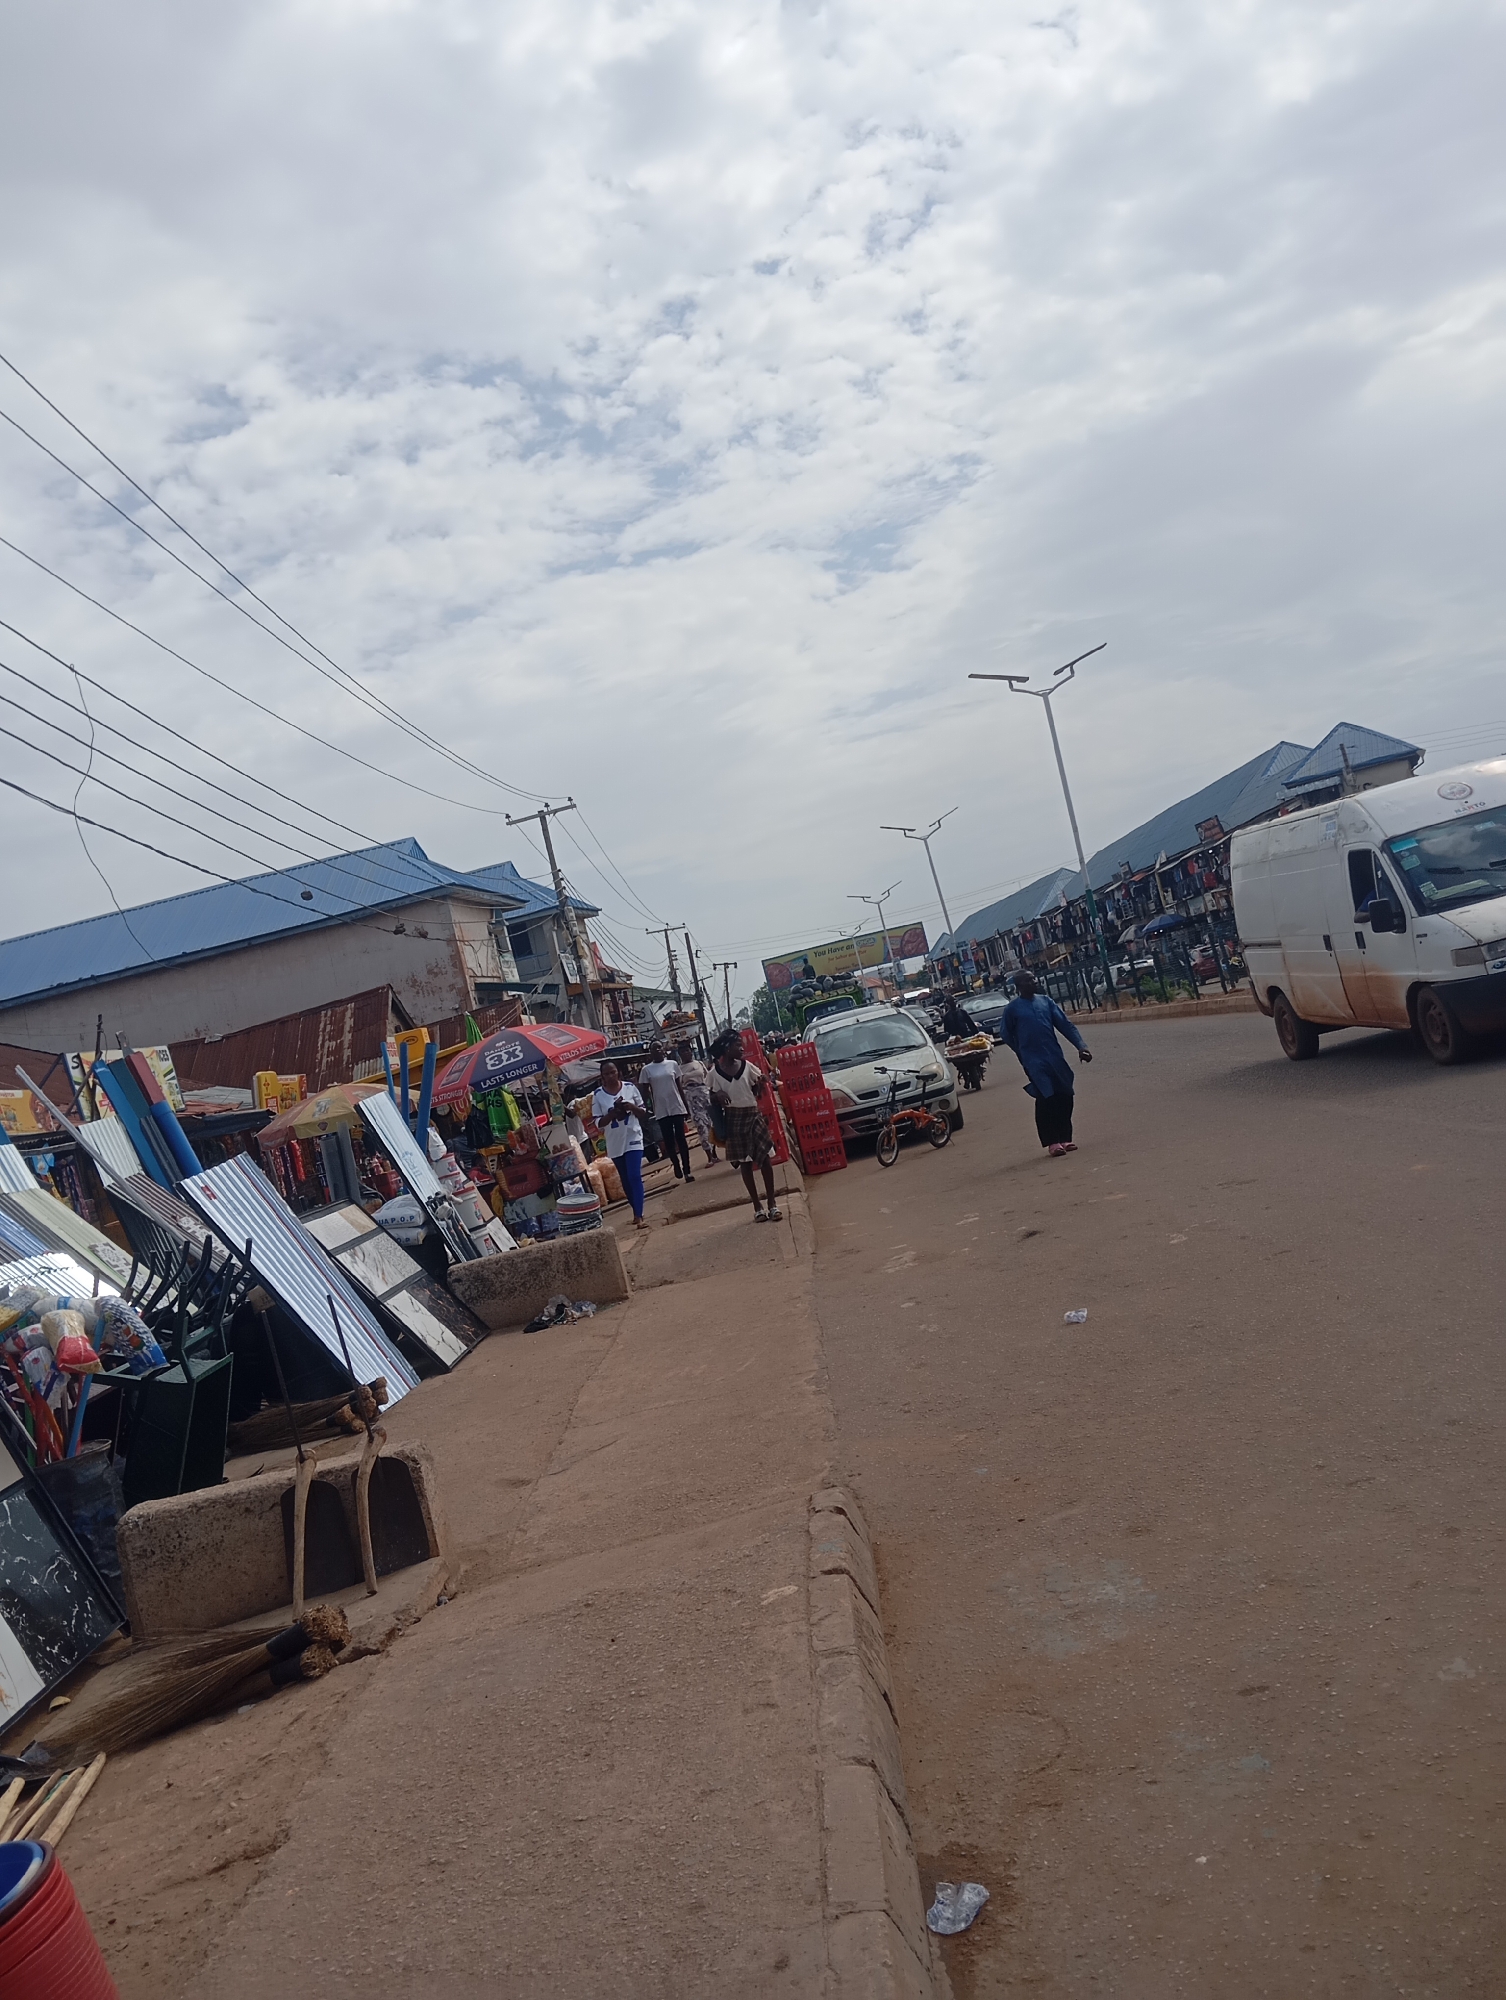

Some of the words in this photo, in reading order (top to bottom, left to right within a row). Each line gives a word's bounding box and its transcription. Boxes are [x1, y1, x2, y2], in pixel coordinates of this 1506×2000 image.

[813, 950, 826, 958] You
[827, 946, 845, 955] Have
[484, 1040, 520, 1056] DANGOTE
[580, 1042, 599, 1054] MORE
[485, 1045, 524, 1071] 3X
[480, 1074, 505, 1089] LASTS
[506, 1063, 538, 1079] LONGER
